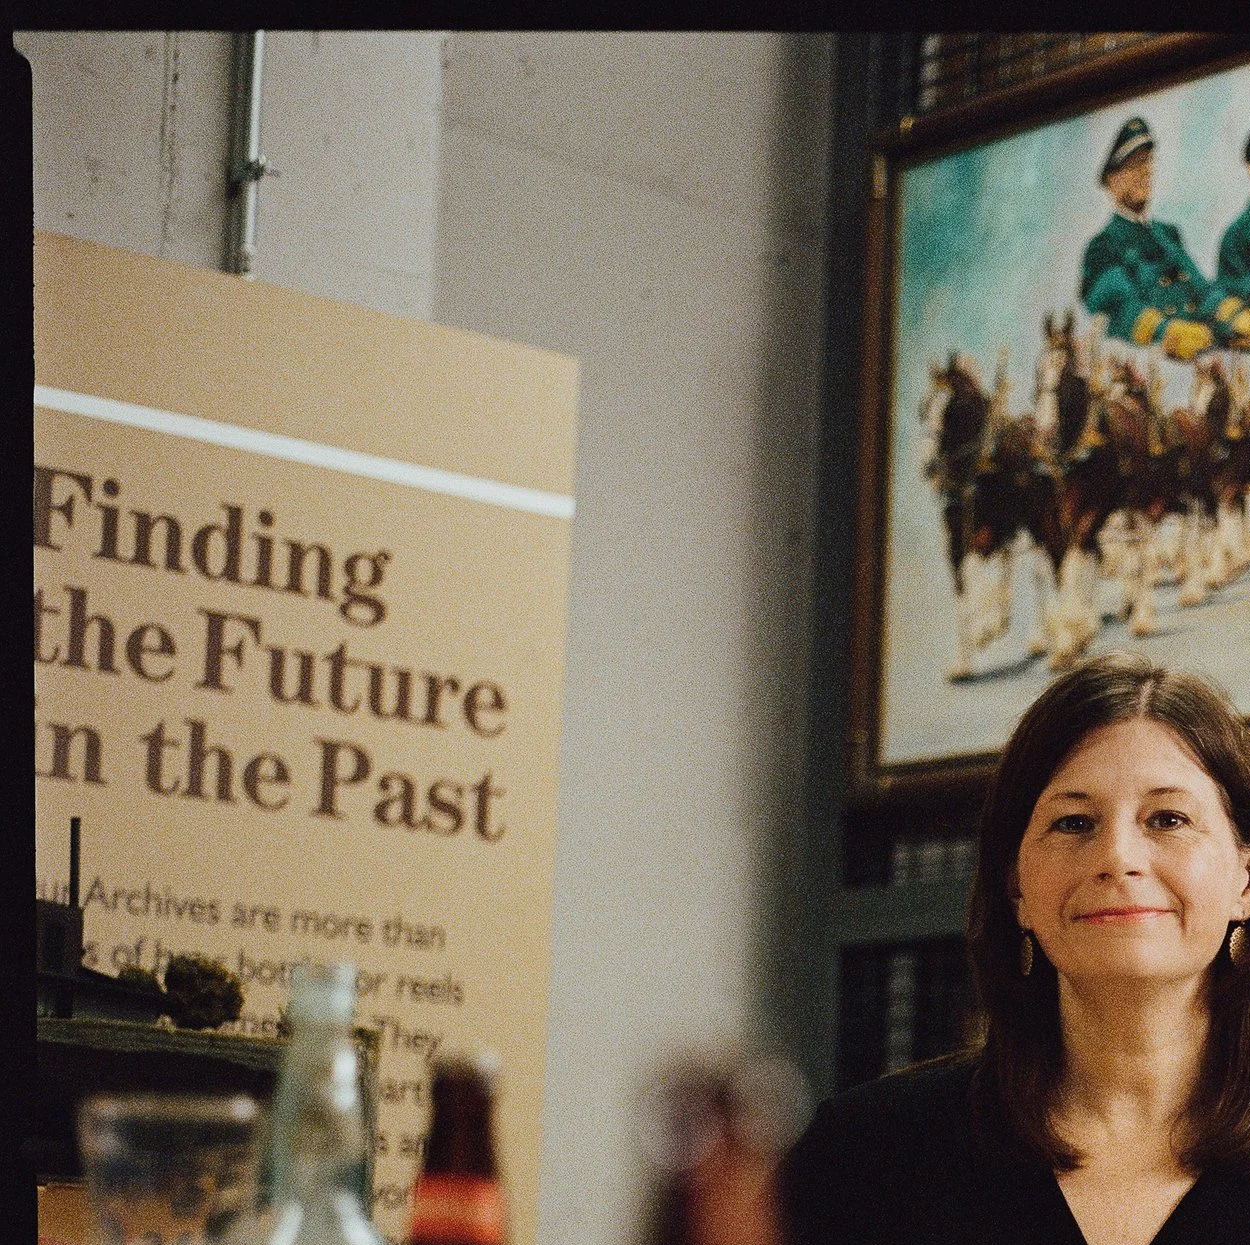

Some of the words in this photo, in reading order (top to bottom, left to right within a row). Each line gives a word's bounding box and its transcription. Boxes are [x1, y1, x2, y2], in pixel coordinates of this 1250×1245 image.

[35, 465, 391, 627] Finding
[35, 585, 176, 683] the
[194, 606, 508, 738] Future
[36, 719, 107, 787] n
[139, 717, 292, 812] the
[310, 735, 506, 843] Past
[84, 876, 222, 925] Archives
[232, 900, 281, 933] are
[290, 908, 374, 943] more
[382, 913, 447, 951] than
[111, 935, 148, 967] of
[396, 972, 466, 1007] reels
